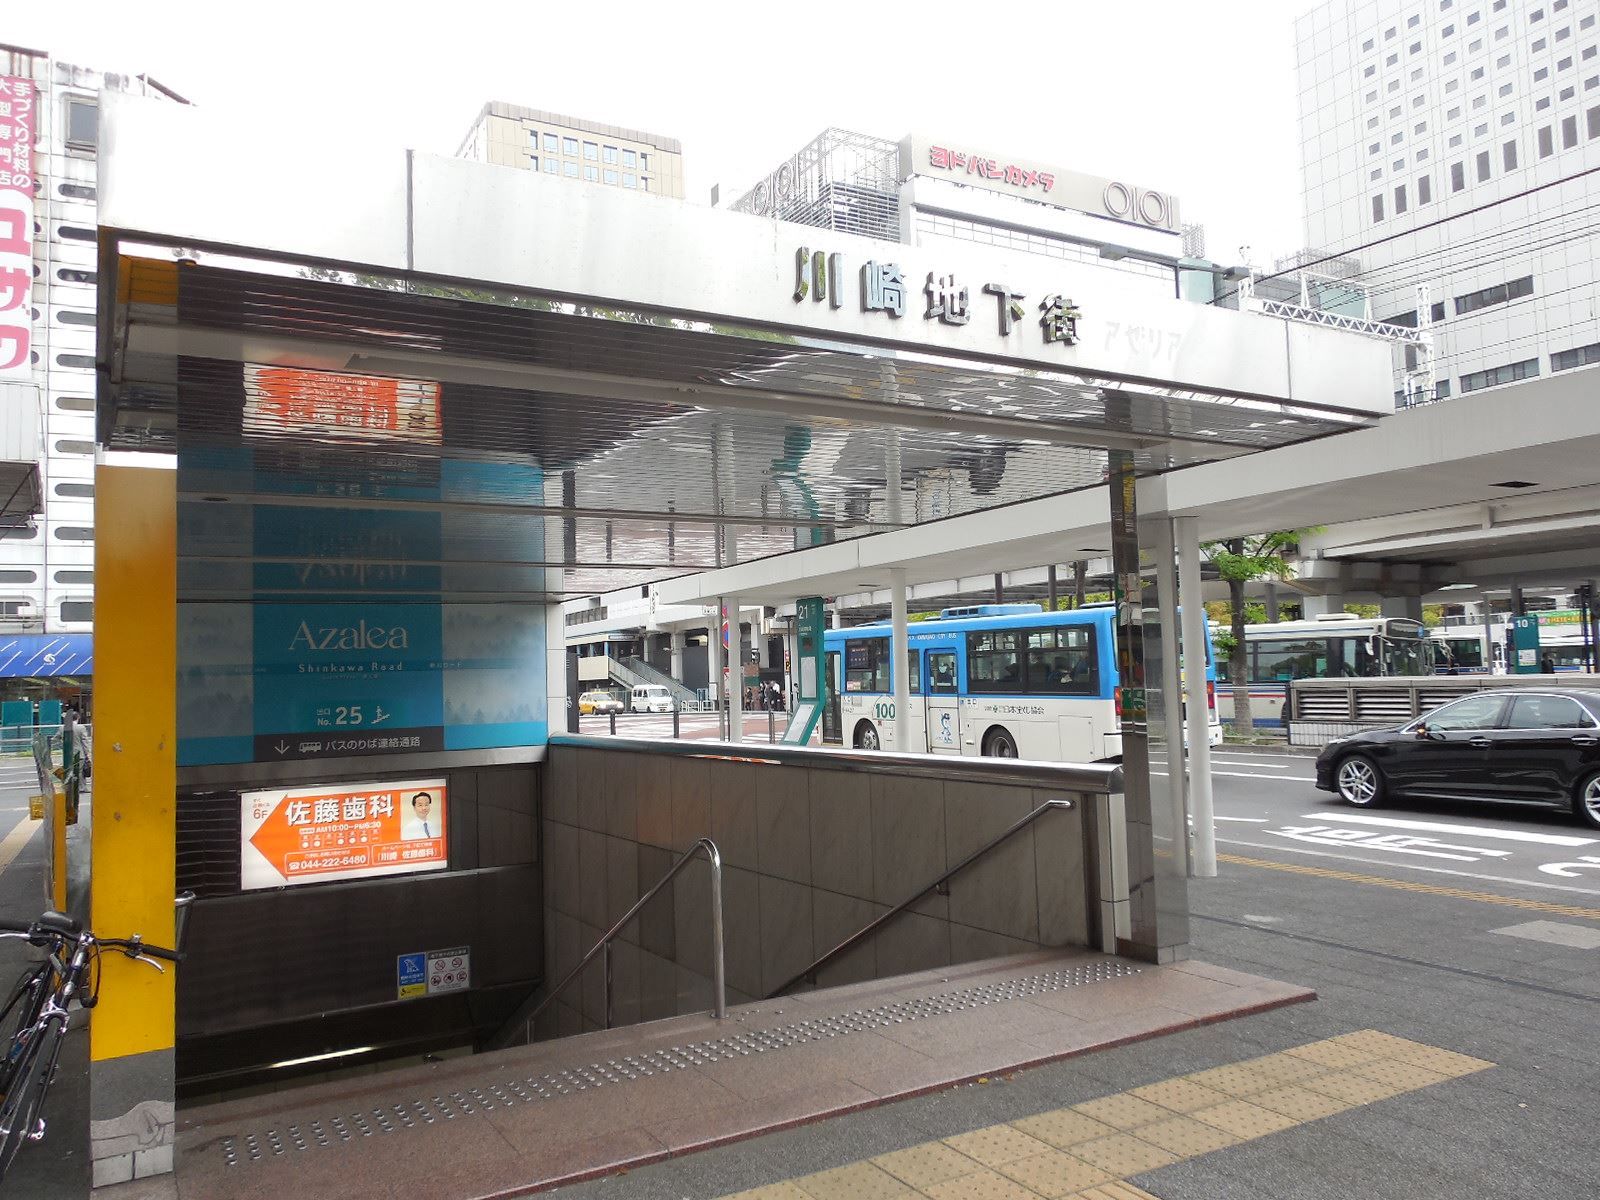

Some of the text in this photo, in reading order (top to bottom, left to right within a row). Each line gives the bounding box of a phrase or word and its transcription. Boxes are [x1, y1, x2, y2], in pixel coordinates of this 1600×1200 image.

[13, 81, 31, 188] 手づくり材料の
[929, 145, 1056, 192] ヨドバシカメラ
[793, 246, 1083, 346] 川崎地下街
[798, 604, 808, 620] 21
[1516, 618, 1529, 628] 10
[288, 619, 409, 650] Azalea
[298, 661, 403, 673] Shinkawa Road
[316, 707, 331, 716] 出口
[317, 706, 363, 726] No. 25
[876, 703, 896, 720] 100
[325, 736, 421, 752] バスのりば連絡通路
[253, 808, 268, 820] 6F
[285, 794, 394, 826] 佐藤歯科
[1261, 825, 1514, 862] 停
[300, 854, 367, 870] 044-222-6480
